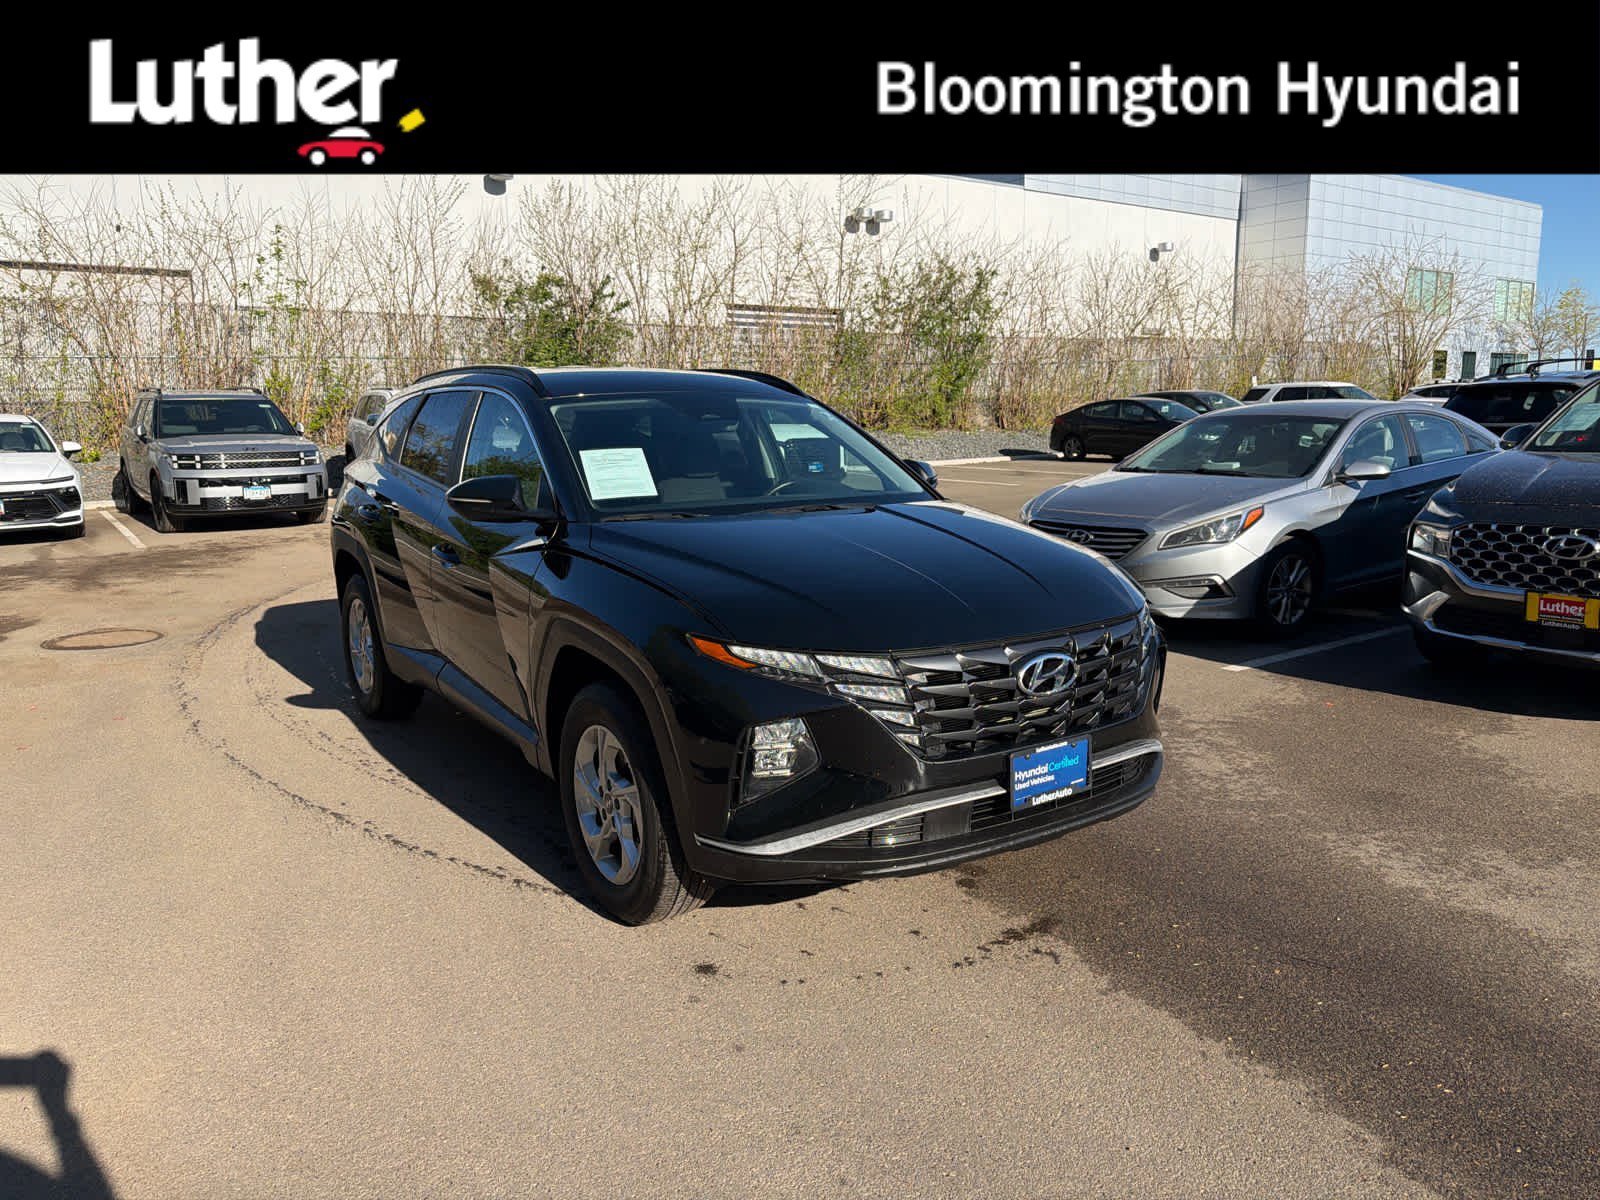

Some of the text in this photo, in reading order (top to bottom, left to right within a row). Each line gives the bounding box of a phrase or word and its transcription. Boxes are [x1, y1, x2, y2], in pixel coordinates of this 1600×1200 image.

[1540, 599, 1584, 615] Luther
[1014, 775, 1055, 791] Used Vehicles
[1032, 787, 1072, 806] LutherAuto
